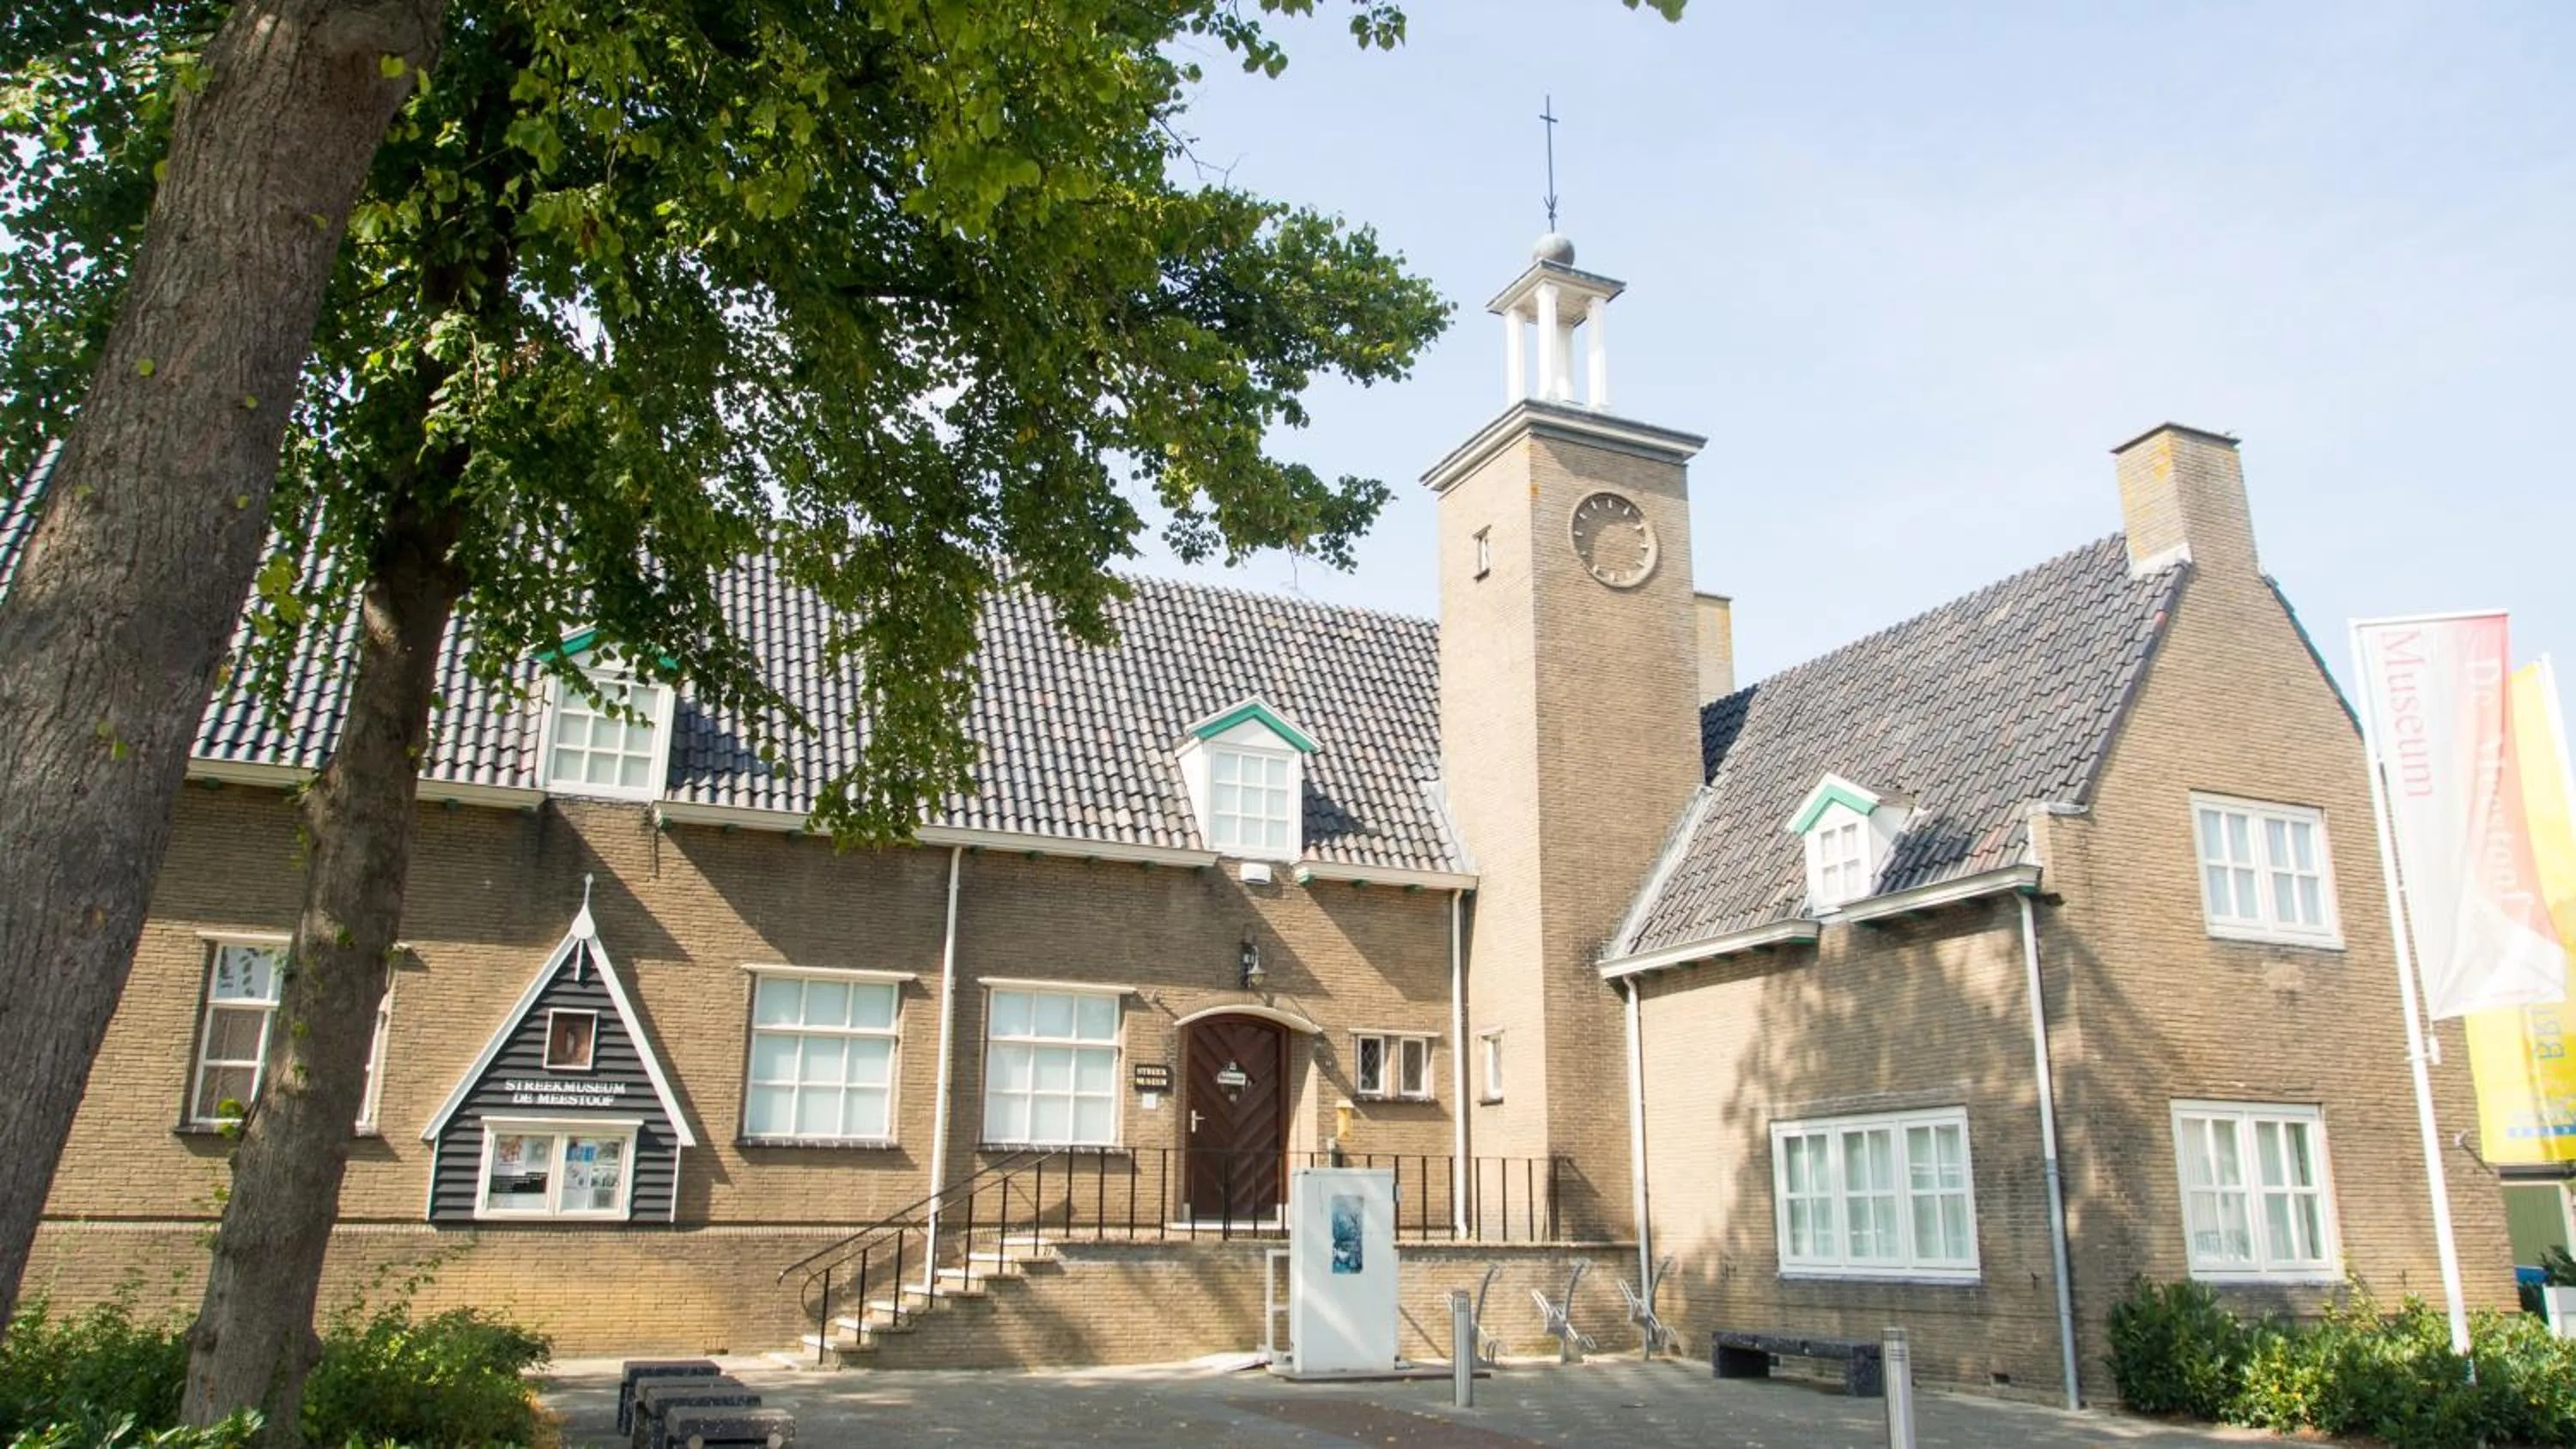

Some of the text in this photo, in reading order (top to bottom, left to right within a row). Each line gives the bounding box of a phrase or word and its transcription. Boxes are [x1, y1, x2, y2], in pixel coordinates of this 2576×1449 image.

[2464, 657, 2502, 707] De
[2381, 628, 2433, 797] Museum
[505, 1080, 627, 1094] STREEKMUSEUM
[513, 1094, 614, 1106] DE MEESTOOF
